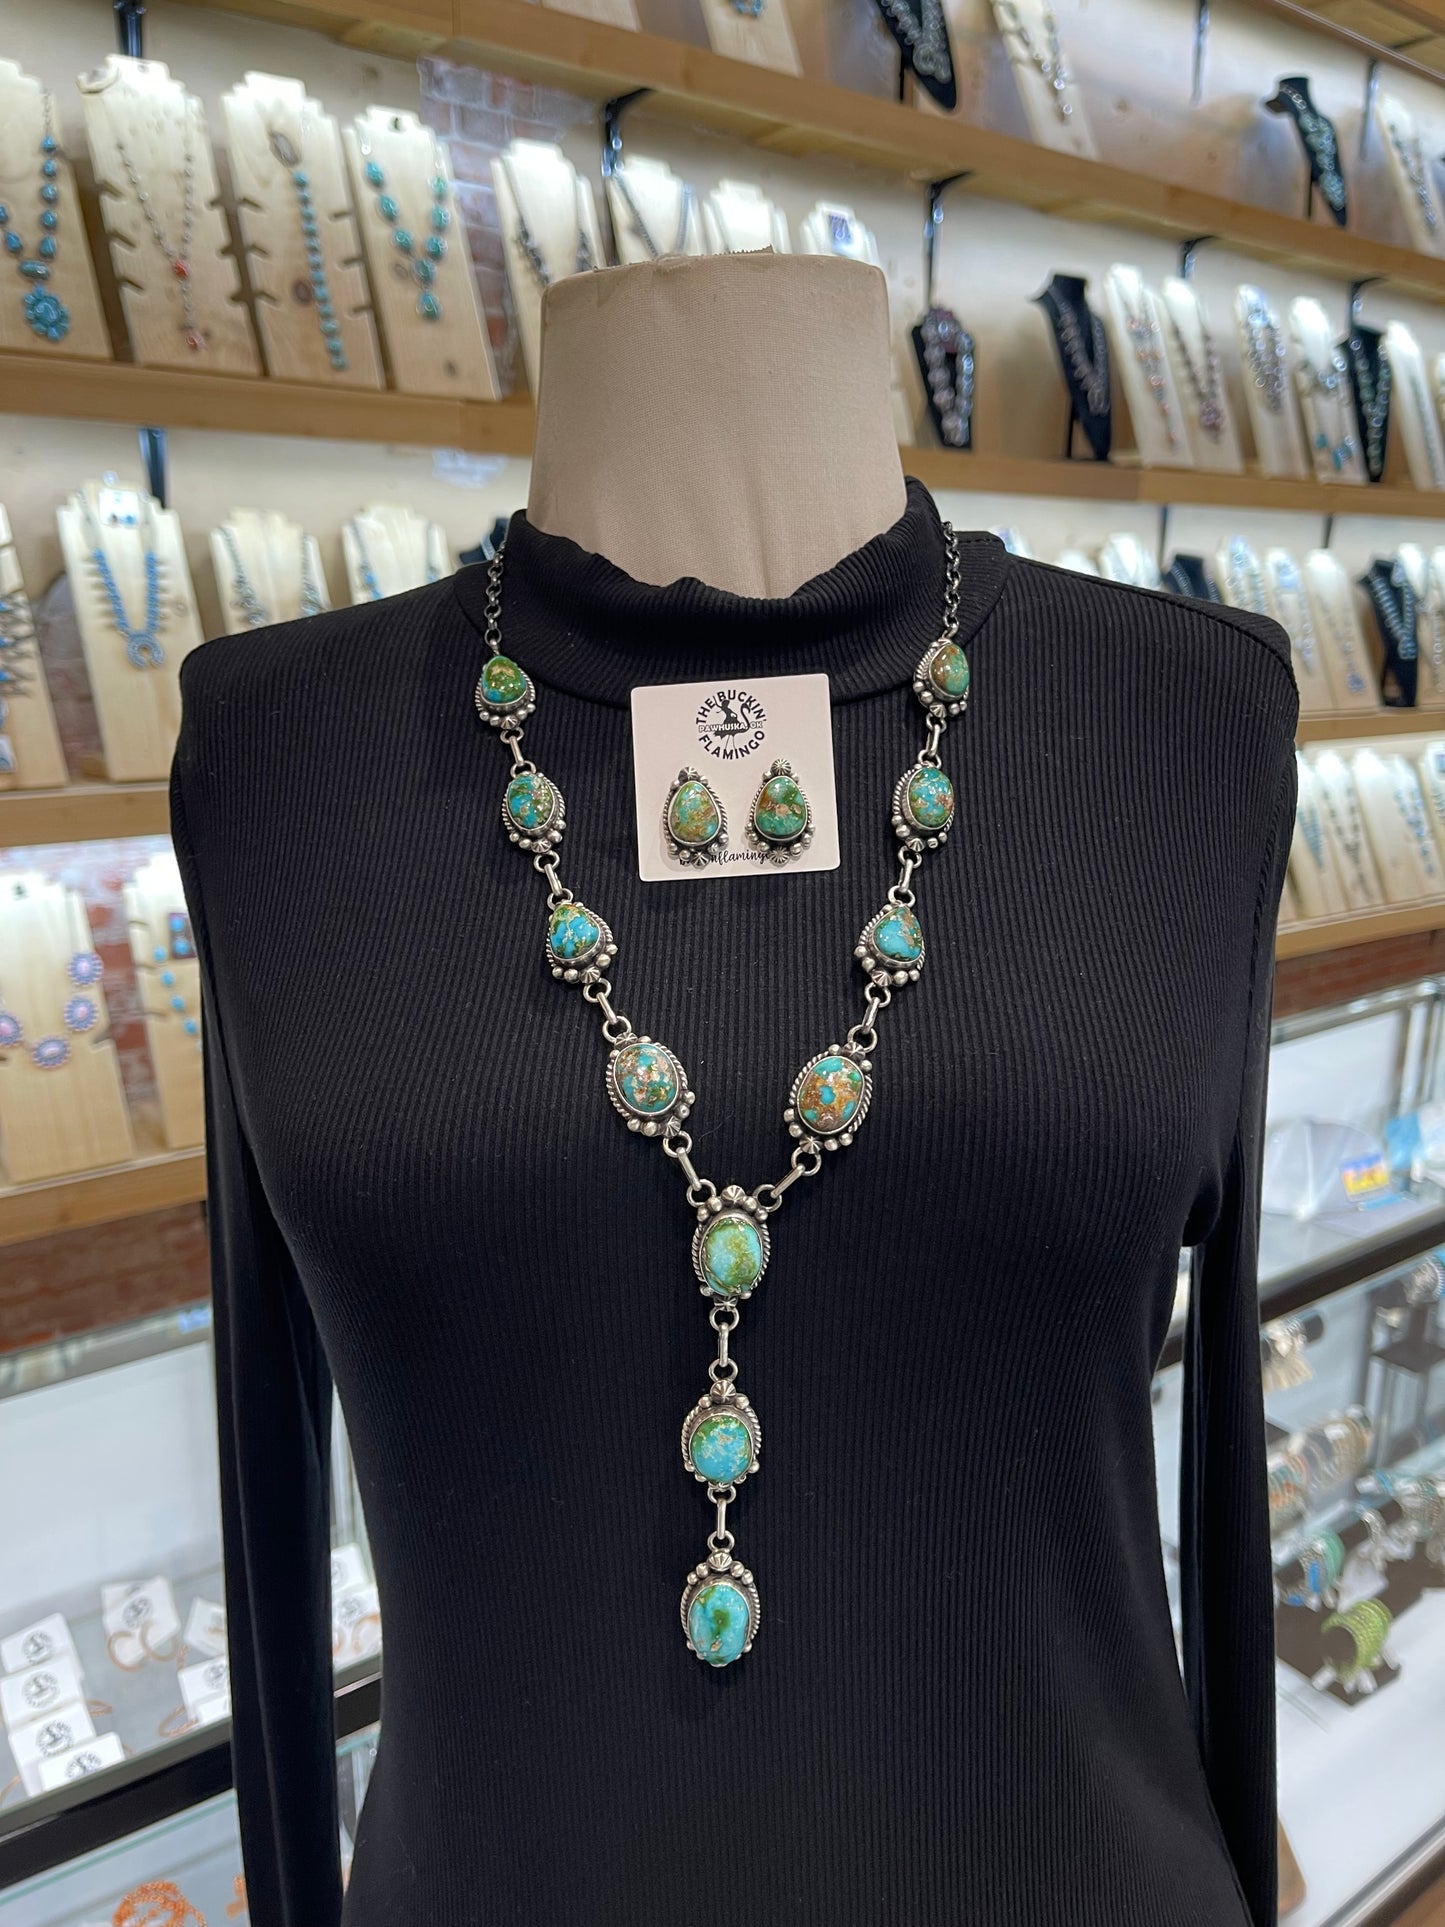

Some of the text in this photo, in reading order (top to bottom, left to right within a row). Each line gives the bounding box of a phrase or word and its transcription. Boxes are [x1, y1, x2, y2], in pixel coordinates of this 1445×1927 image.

[695, 698, 717, 725] THE
[750, 721, 763, 729] OK
[698, 730, 765, 760] FLAMINGO
